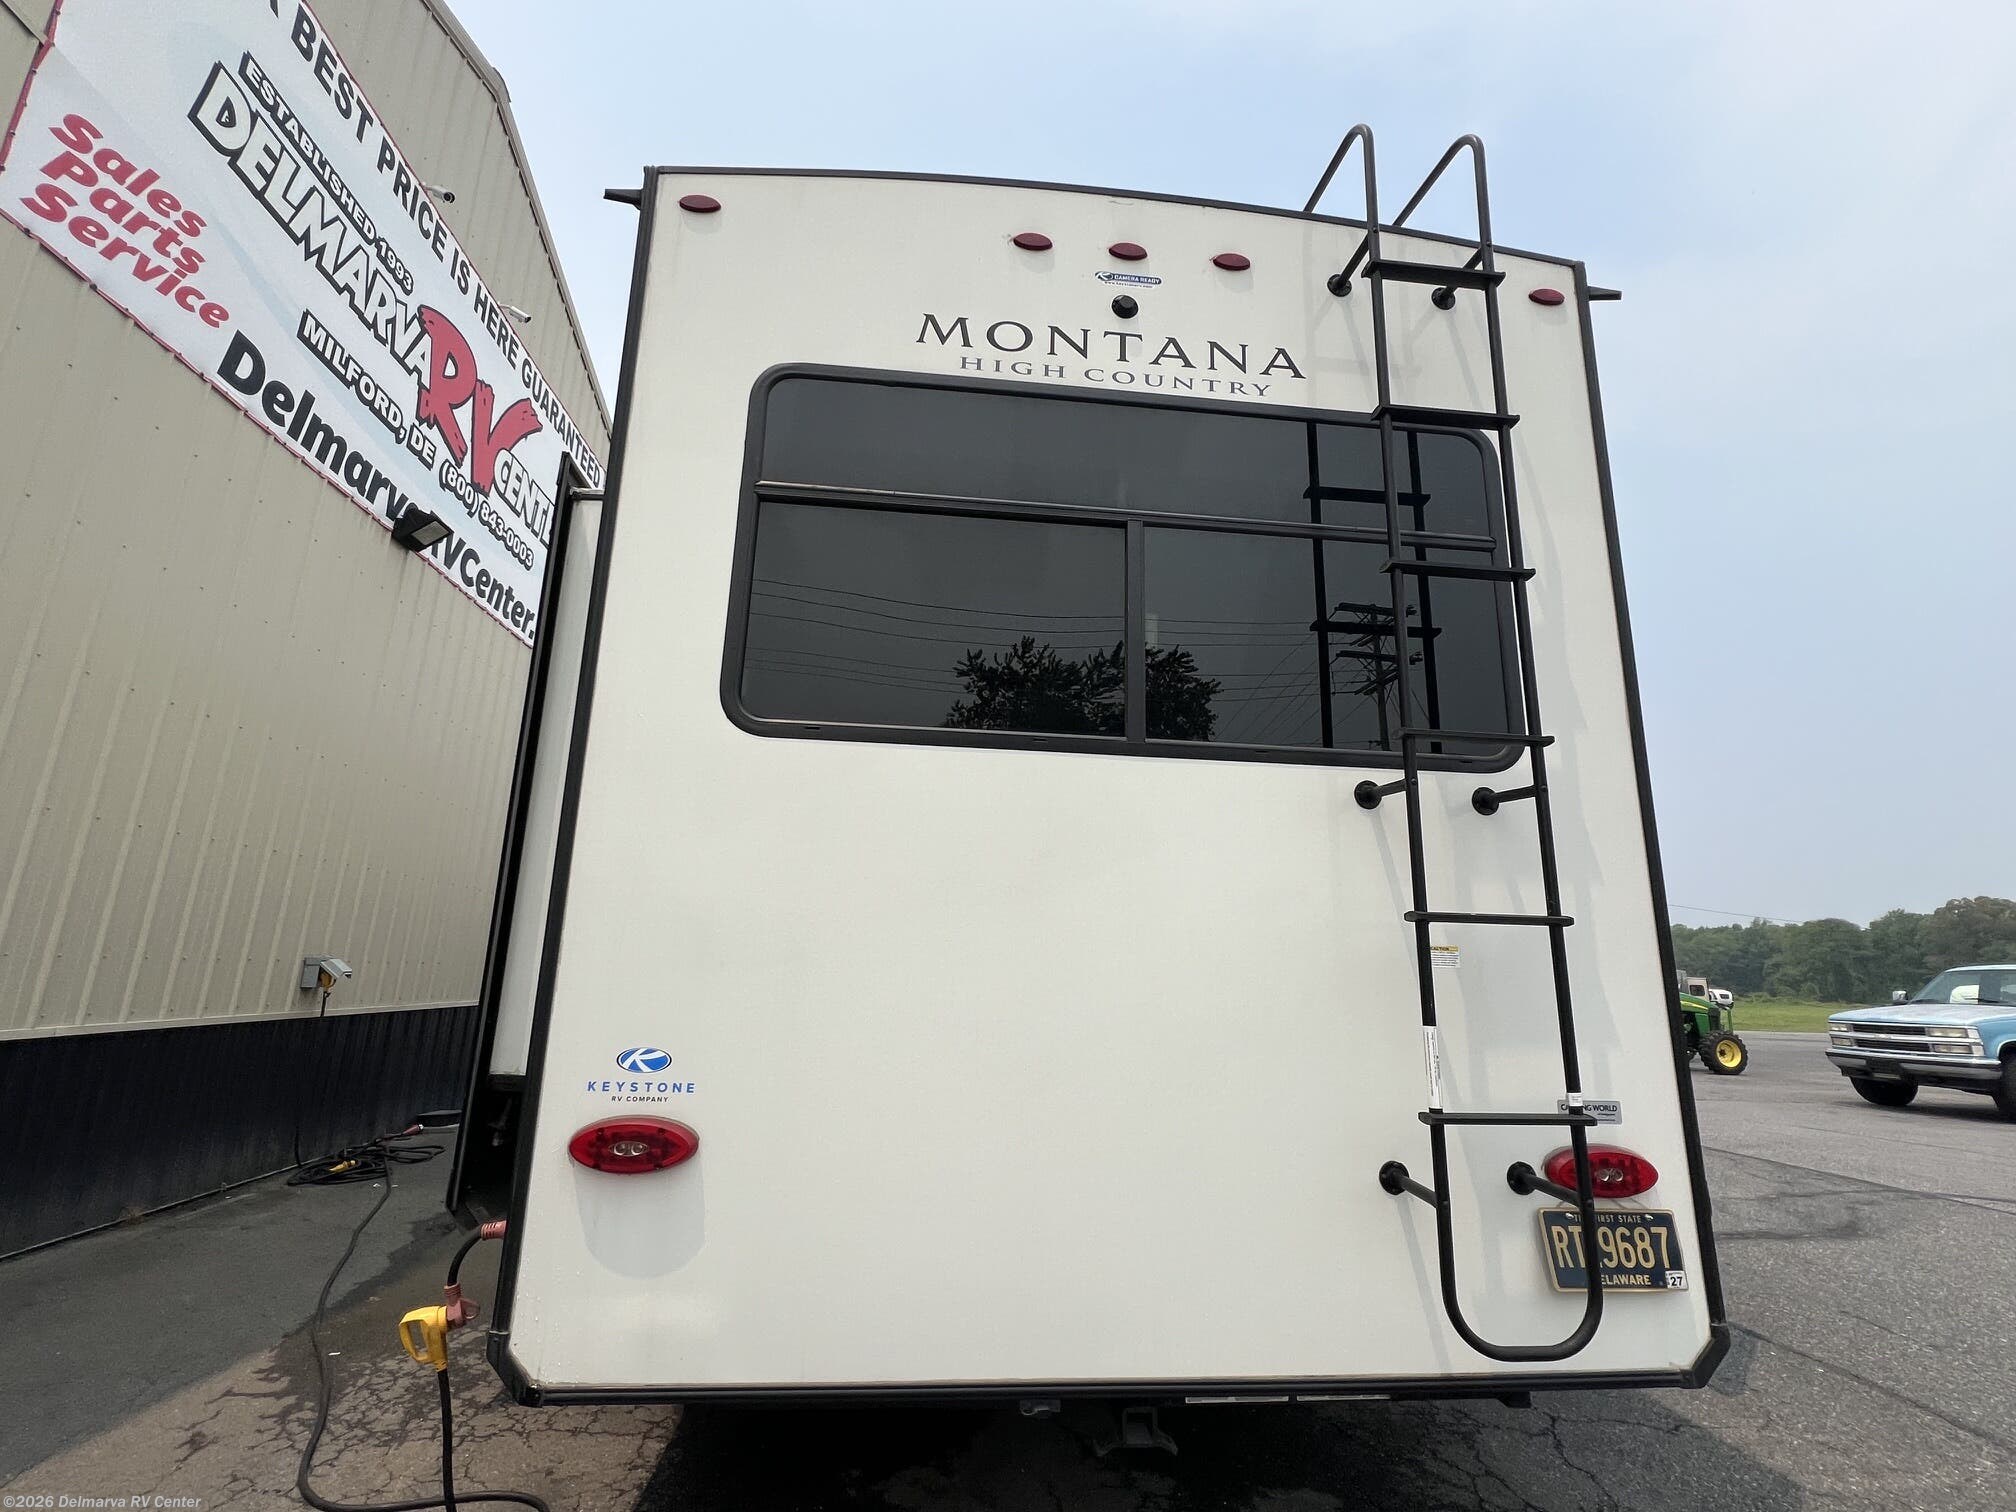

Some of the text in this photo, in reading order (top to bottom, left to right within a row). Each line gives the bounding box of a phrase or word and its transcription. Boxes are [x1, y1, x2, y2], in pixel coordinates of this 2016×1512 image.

[40, 150, 206, 274] Parts
[48, 113, 208, 238] Sales
[238, 50, 414, 297] ESTABLISHED 1993
[19, 183, 230, 329] Service
[187, 60, 433, 390] DELMARVA
[291, 2, 601, 489] BEST PRICE IS HERE GUARANTEED
[915, 312, 1307, 380] MONTANA
[960, 355, 1272, 398] HIGH COUNTRY
[297, 308, 535, 572] MILFORD, DE (800) 843-0003
[417, 304, 544, 499] RV
[587, 1081, 696, 1094] KEYSTONE
[611, 1095, 669, 1104] RV COMPANY
[1592, 1104, 1618, 1112] WORLD
[1618, 1214, 1641, 1224] STATE
[1601, 1273, 1652, 1286] ELAWARE
[1669, 1276, 1683, 1287] 27
